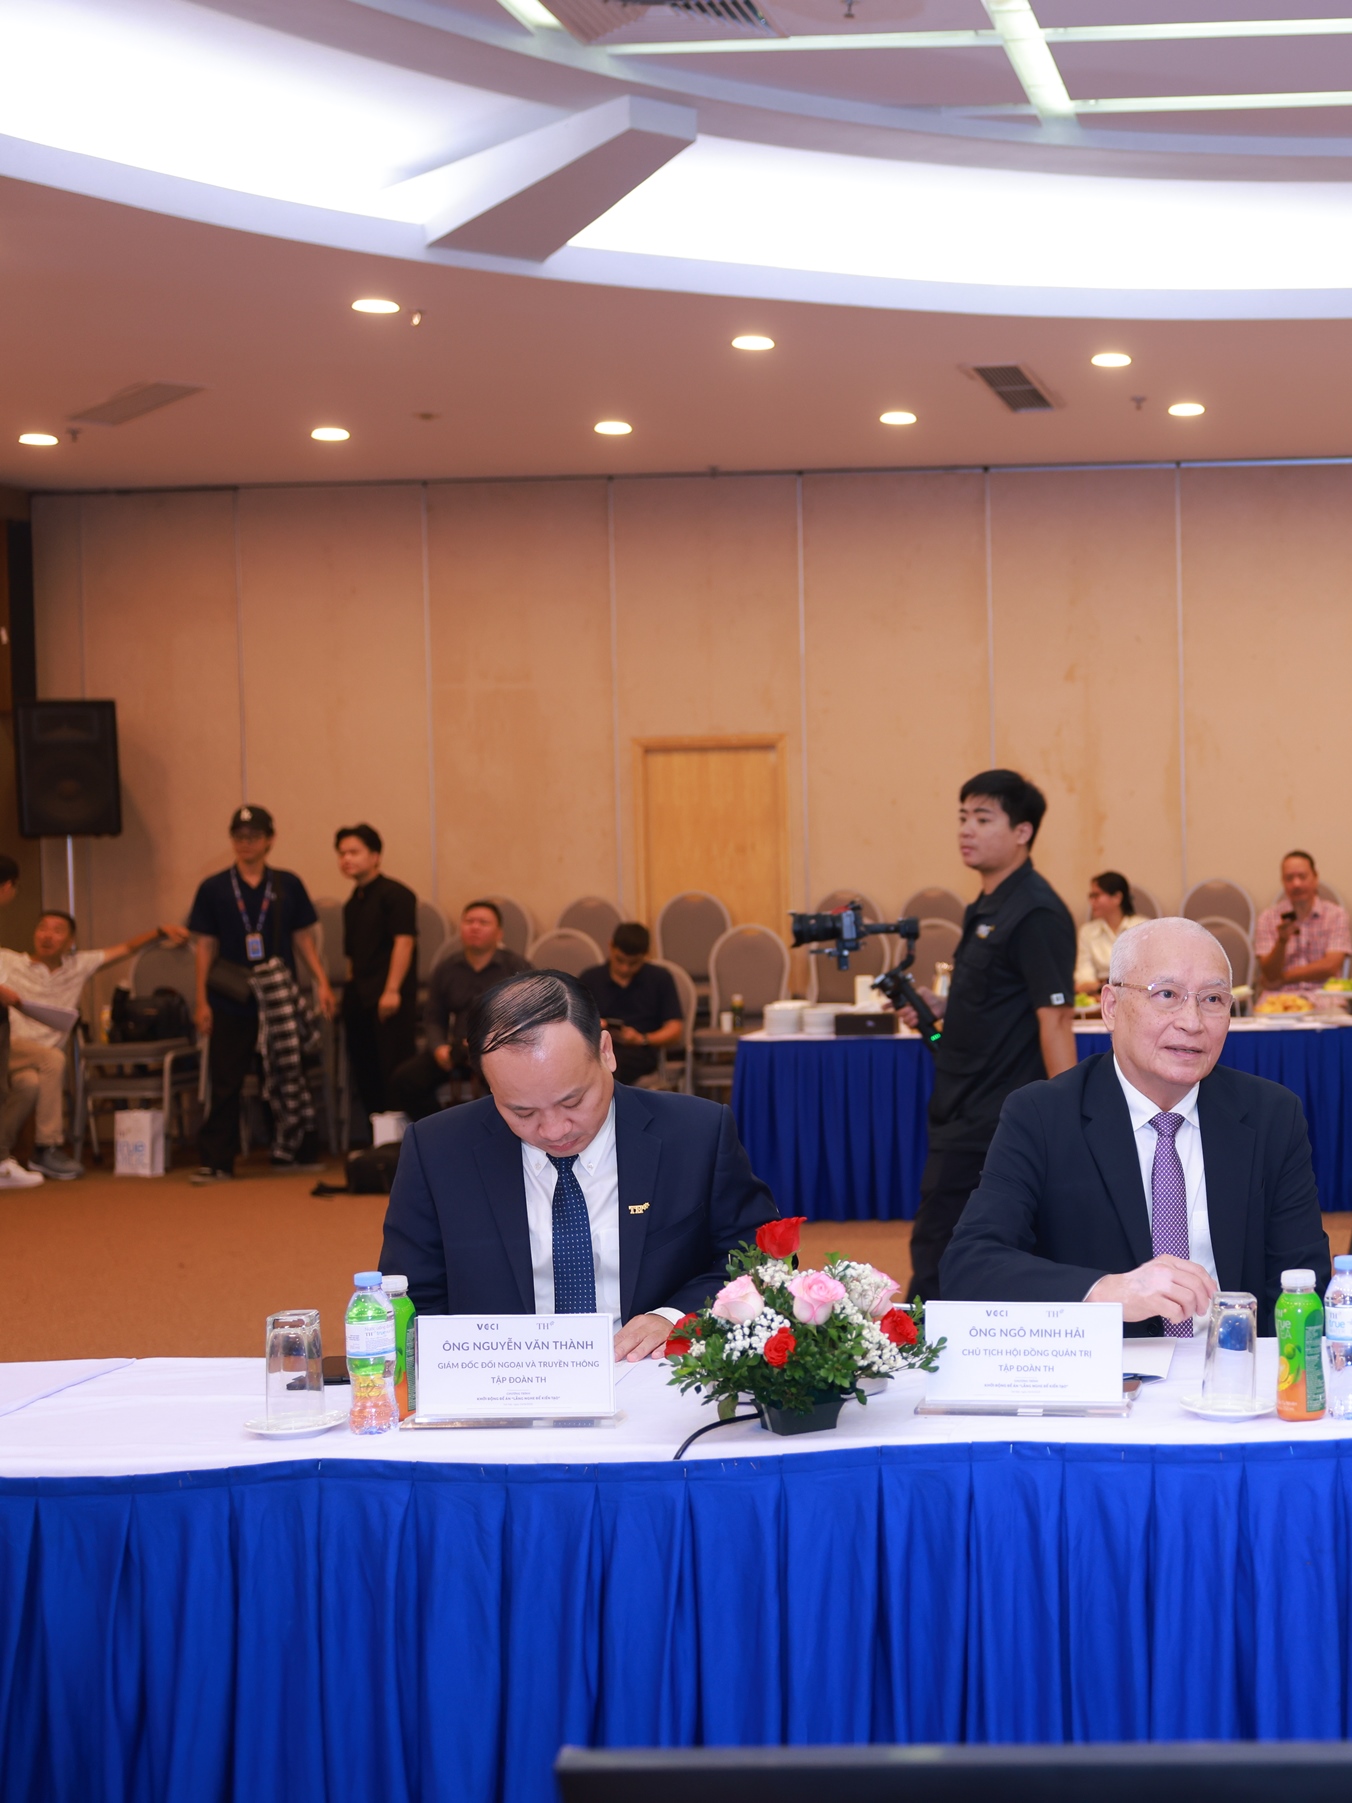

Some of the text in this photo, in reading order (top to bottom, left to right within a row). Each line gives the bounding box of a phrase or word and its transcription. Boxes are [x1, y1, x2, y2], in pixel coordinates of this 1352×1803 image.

[1329, 1320, 1346, 1328] true
[969, 1325, 1085, 1338] ÔNG NGÔ MINH HẢI
[442, 1337, 594, 1351] ÔNG NGUYỄN VĂN THÀNH
[961, 1347, 1092, 1359] CHỦ TỊCH HỘI ĐỒNG QUẢN TRỊ
[437, 1359, 600, 1370] GIÁM ĐỐC ĐỐI NGOẠI VÀ TRUYỀN THÔNG
[998, 1363, 1055, 1374] TẬP ĐOÀN TH
[491, 1375, 547, 1386] TẬP ĐOÀN TH
